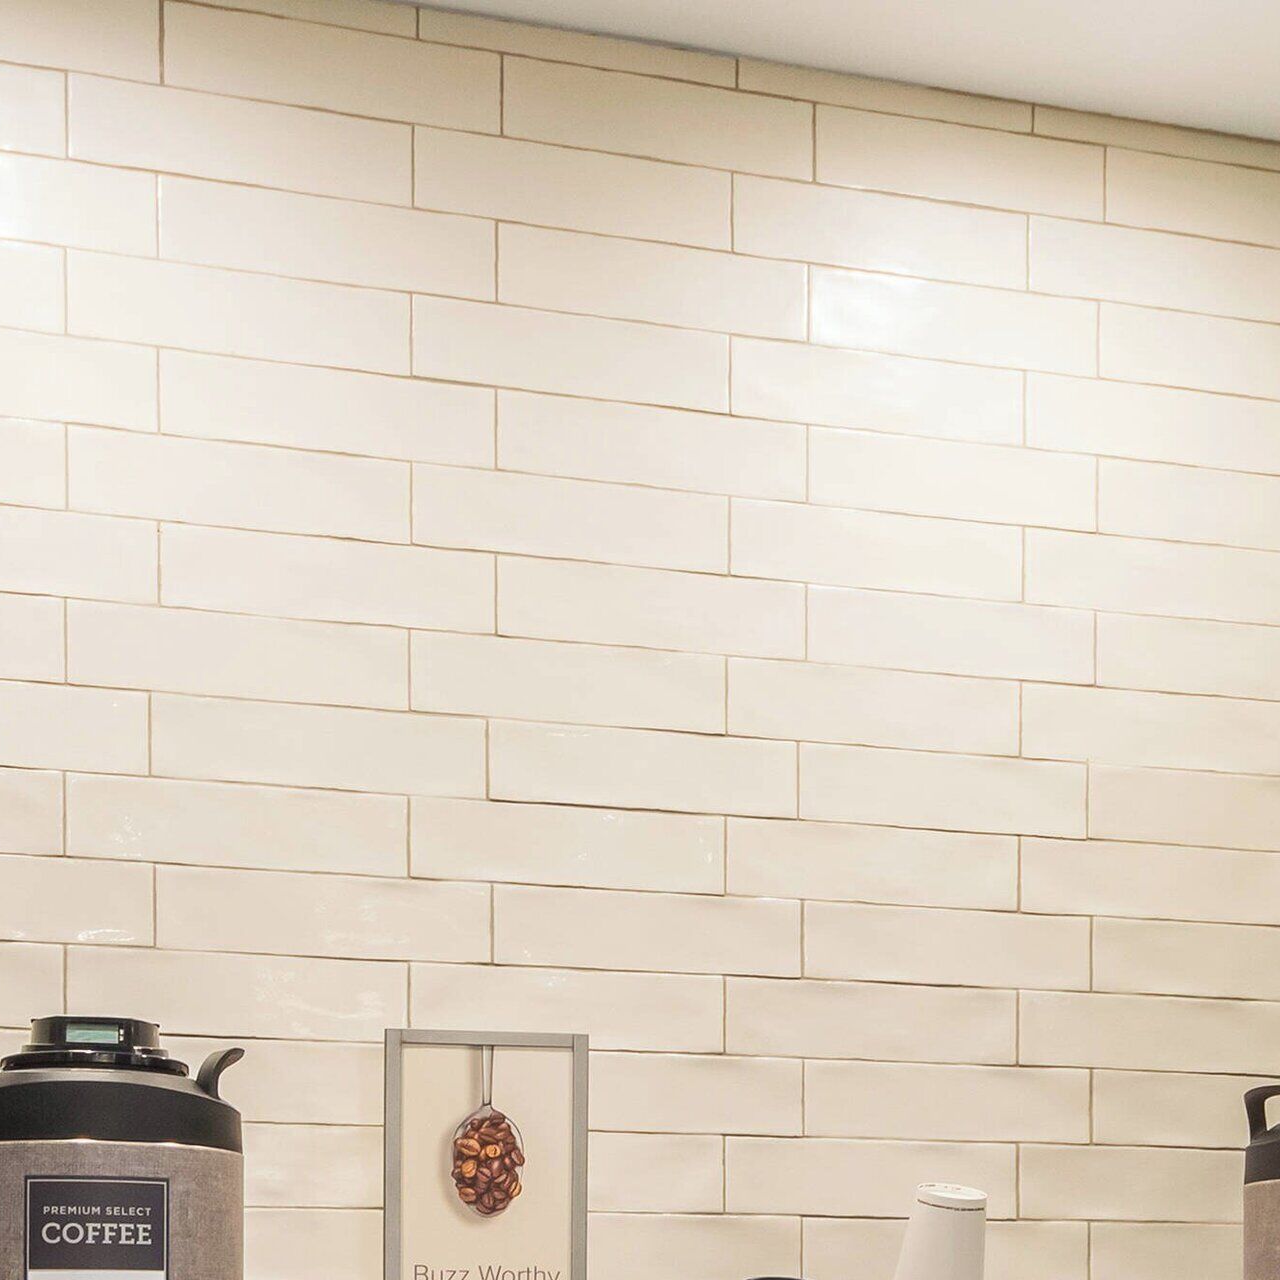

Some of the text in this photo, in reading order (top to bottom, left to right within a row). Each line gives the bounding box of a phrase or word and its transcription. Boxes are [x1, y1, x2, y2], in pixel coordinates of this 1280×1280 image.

[43, 1205, 152, 1217] PREMIUM SELECT
[41, 1222, 152, 1245] COFFEE
